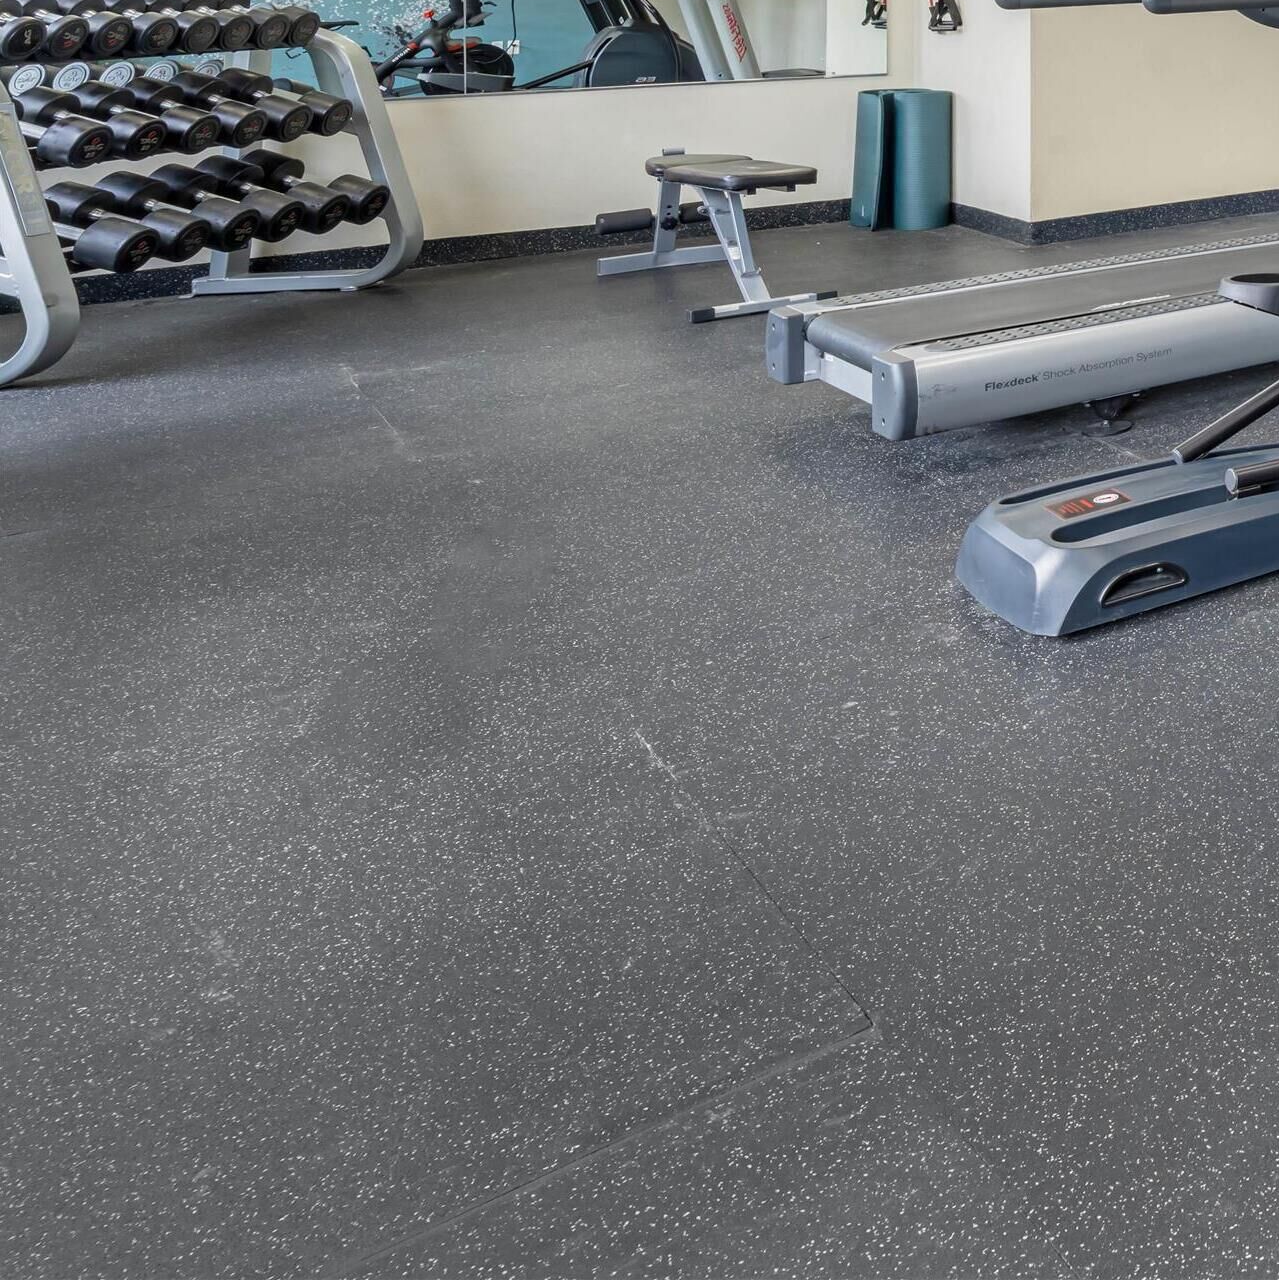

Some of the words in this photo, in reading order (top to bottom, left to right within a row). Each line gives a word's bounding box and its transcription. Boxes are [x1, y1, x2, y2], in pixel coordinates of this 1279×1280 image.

[984, 373, 1040, 392] Flexdeck
[1042, 367, 1076, 381] Shock
[1078, 355, 1135, 372] Absorption
[1136, 347, 1172, 362] System
